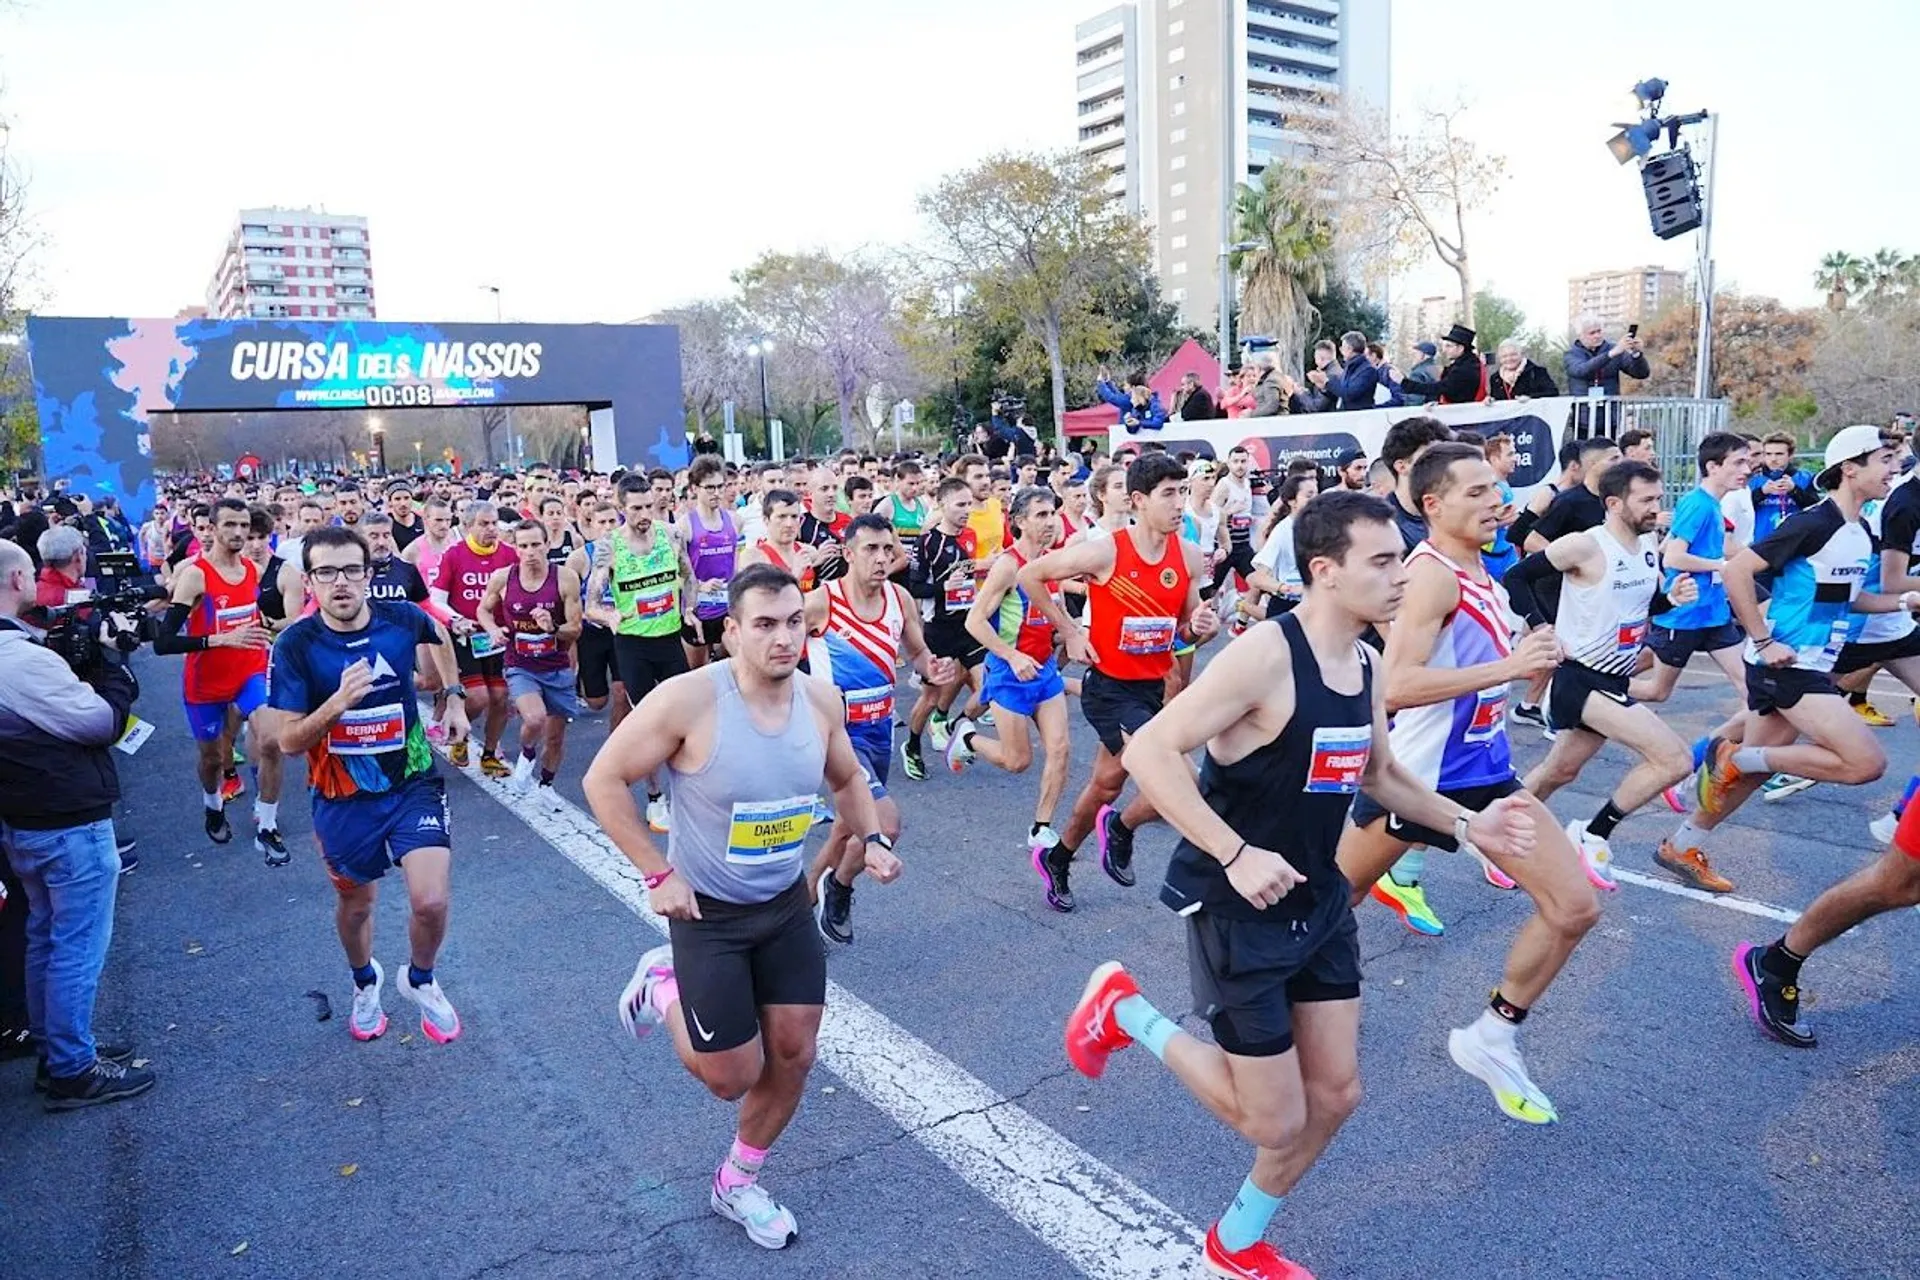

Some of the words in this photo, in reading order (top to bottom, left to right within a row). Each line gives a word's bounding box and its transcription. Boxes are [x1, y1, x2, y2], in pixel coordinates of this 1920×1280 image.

[231, 341, 348, 380] CURSA
[357, 353, 412, 379] DELS
[419, 342, 543, 378] NASSOS
[366, 385, 432, 406] 00:08
[1517, 431, 1533, 445] de
[1333, 446, 1345, 459] d
[345, 722, 389, 737] BERNAT
[753, 819, 795, 837] DANIEL
